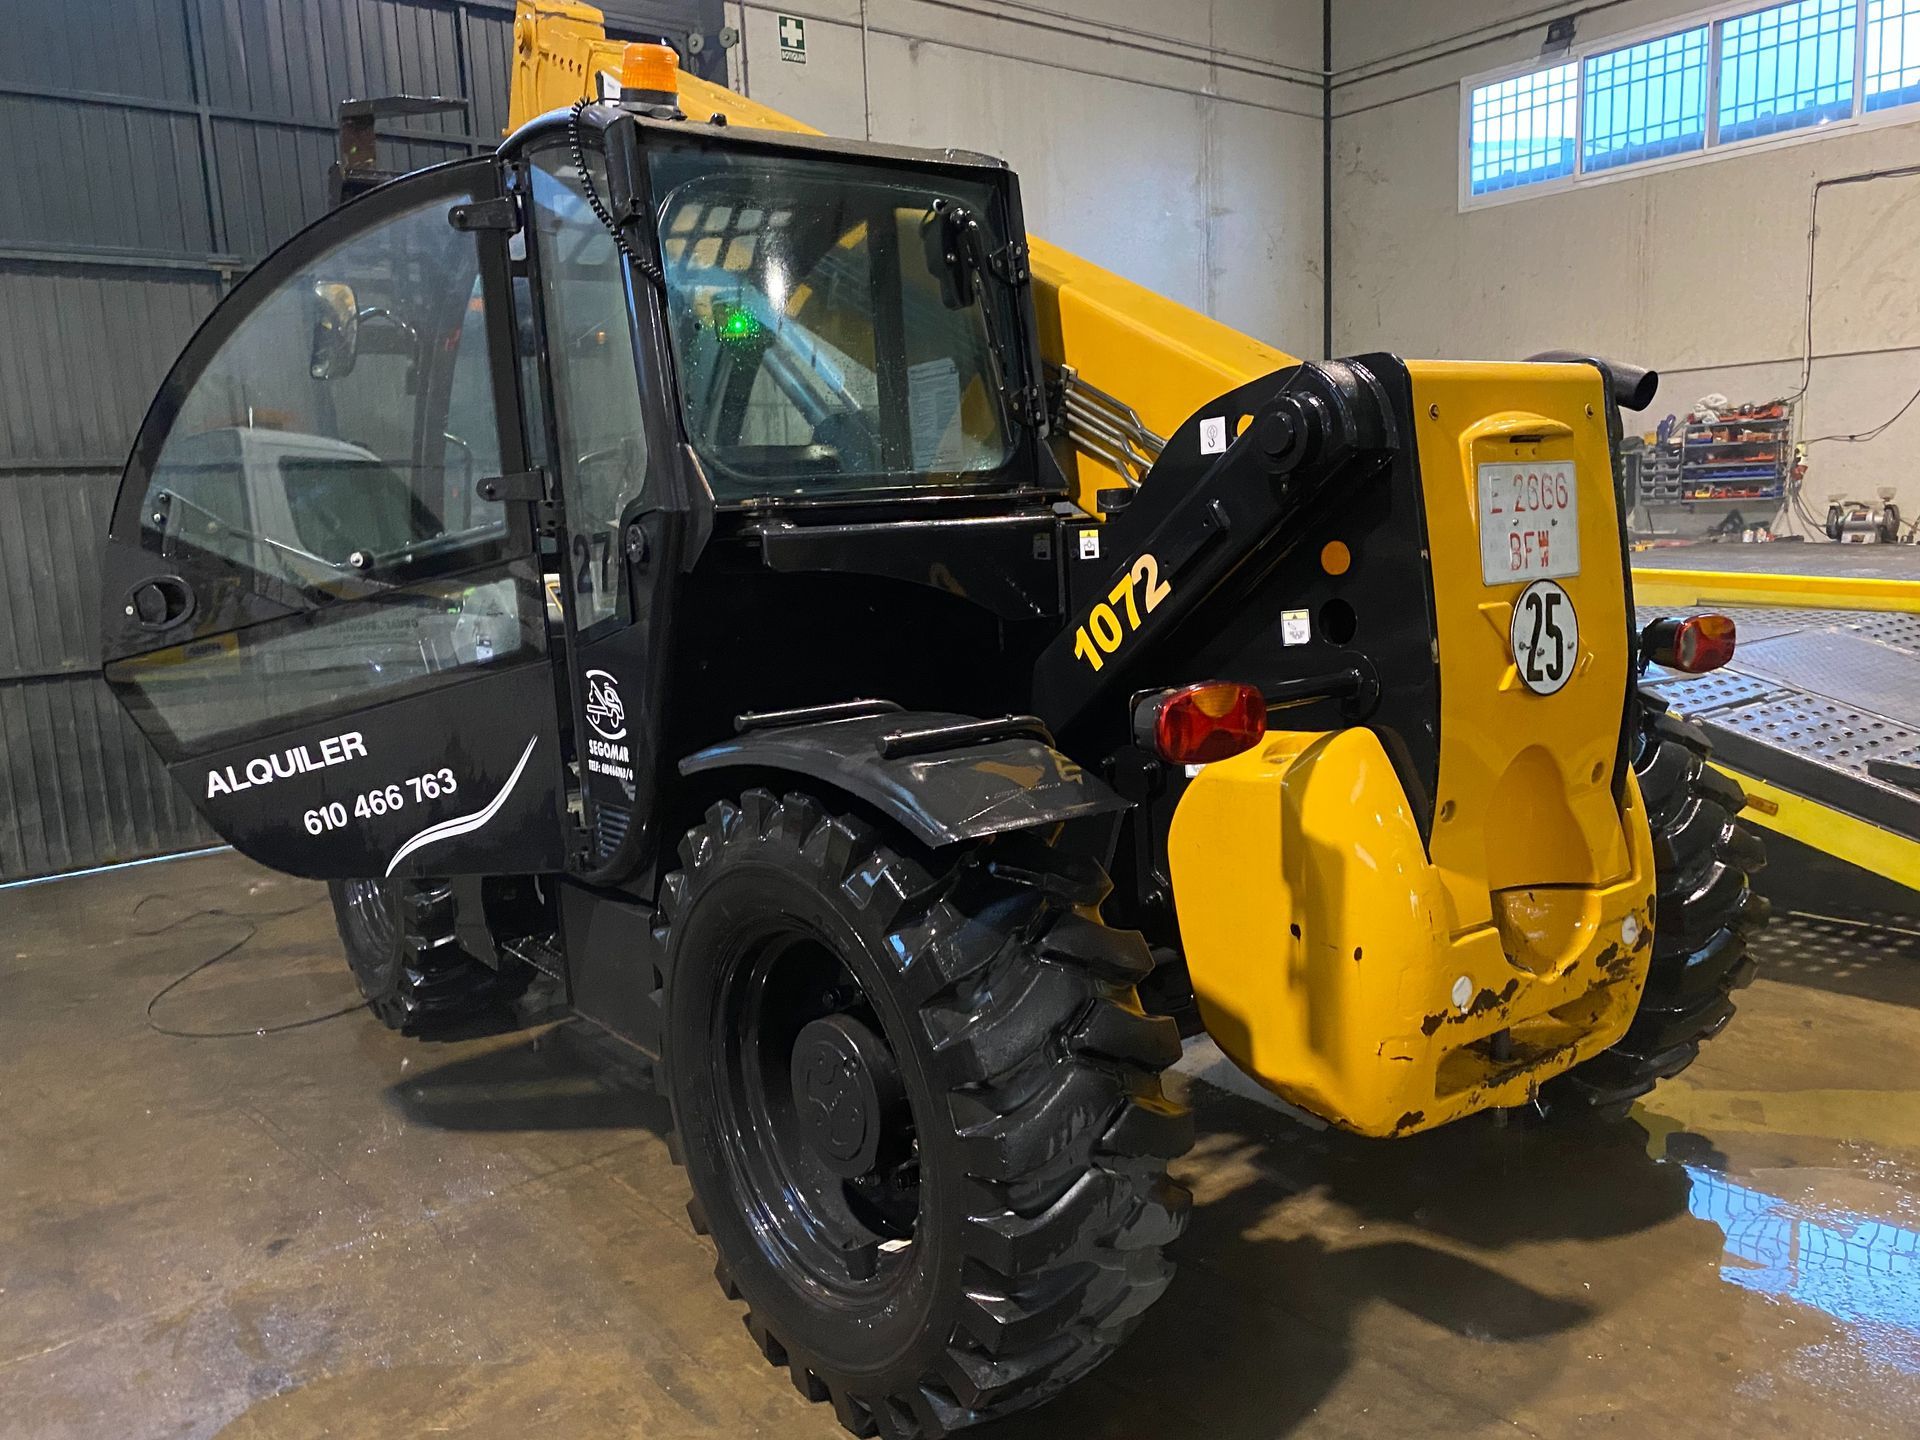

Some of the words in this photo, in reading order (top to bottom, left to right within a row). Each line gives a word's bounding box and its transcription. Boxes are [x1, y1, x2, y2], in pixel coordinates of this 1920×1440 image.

[1074, 553, 1172, 672] 1072
[1526, 591, 1564, 682] 25
[207, 731, 368, 799] ALQUILER
[588, 739, 630, 763] SEGOMAR
[303, 801, 348, 836] 610
[354, 784, 404, 820] 466
[405, 768, 458, 804] 763
